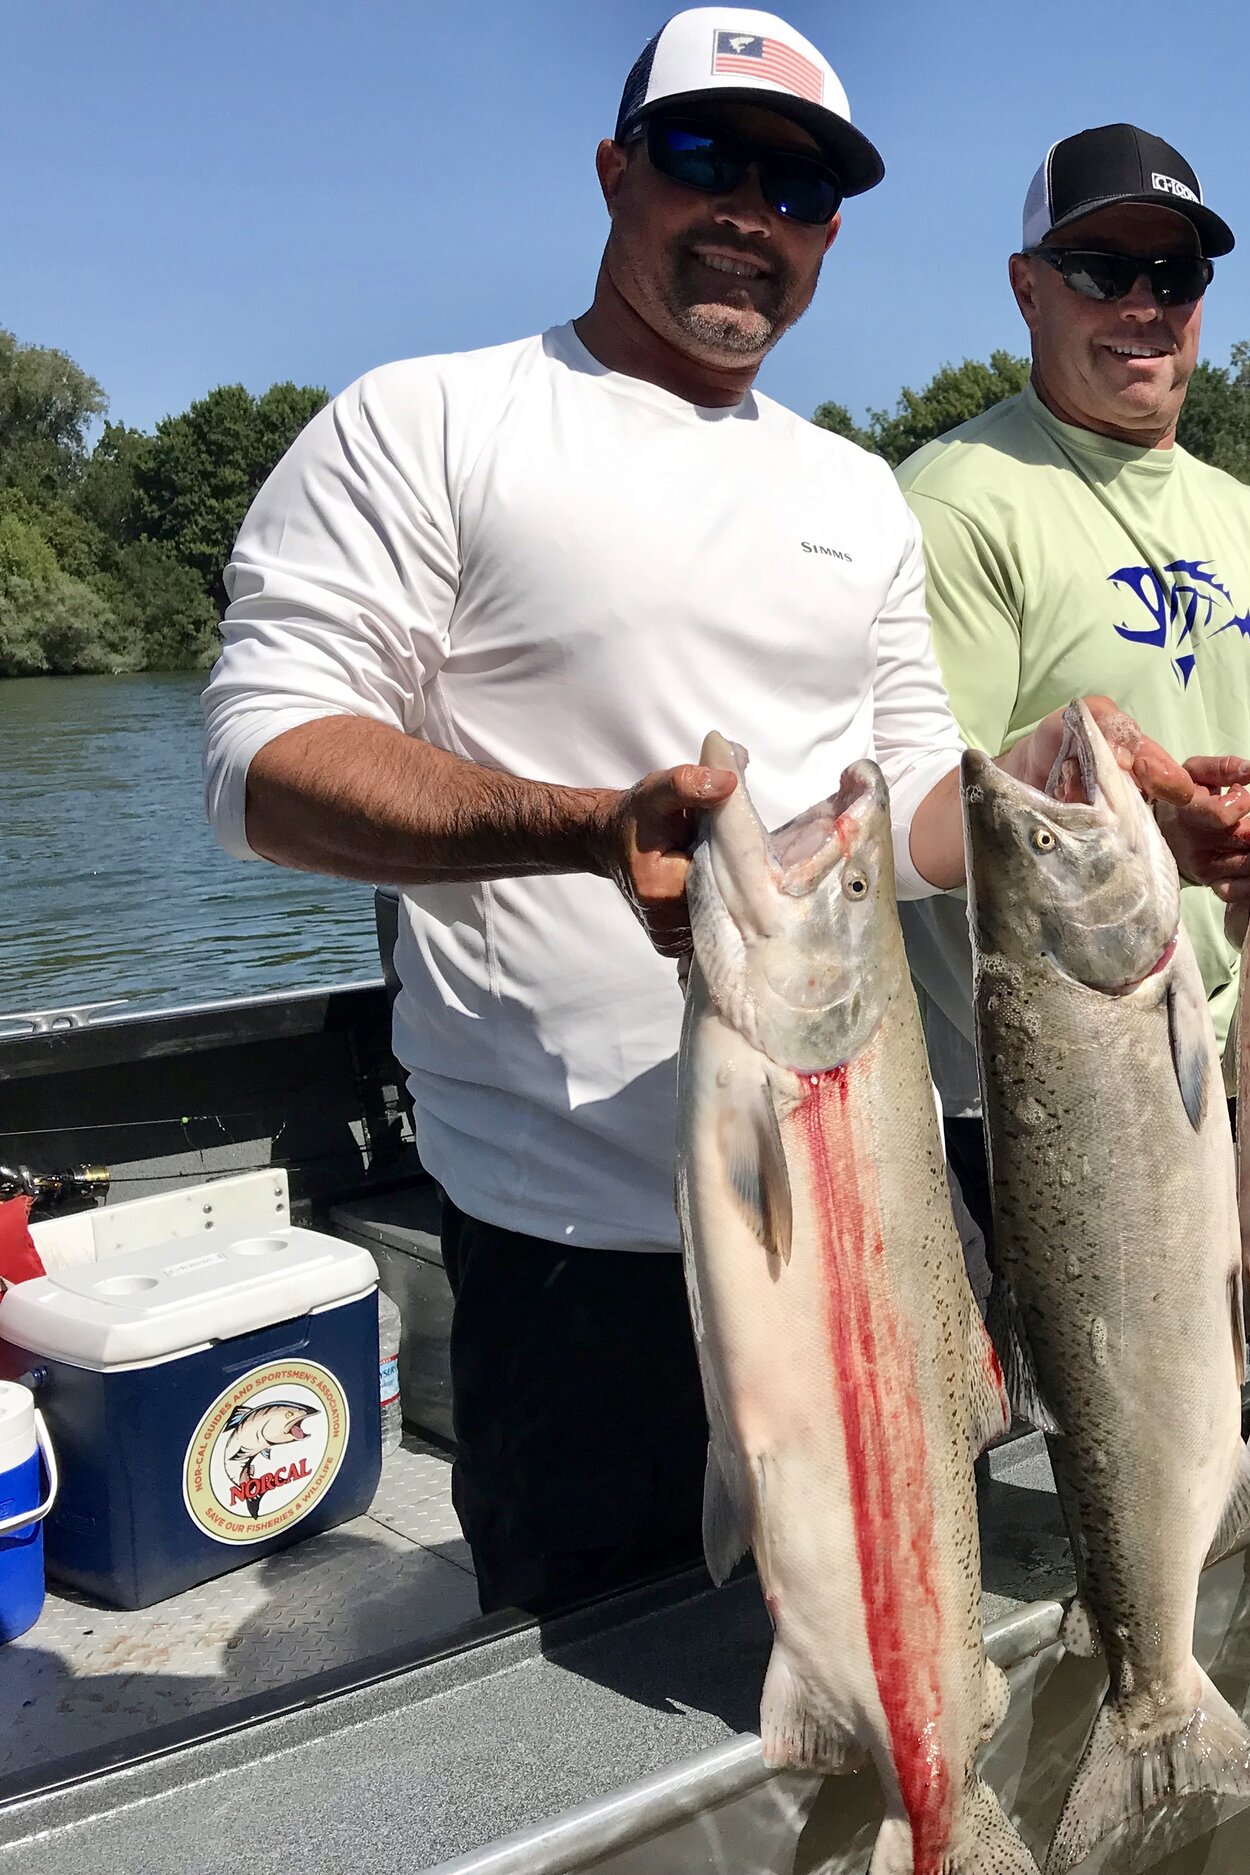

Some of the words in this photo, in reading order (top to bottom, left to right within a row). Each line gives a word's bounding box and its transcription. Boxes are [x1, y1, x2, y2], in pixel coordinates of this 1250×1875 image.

[801, 541, 853, 563] SIMMS
[194, 1442, 209, 1493] NOR-CAL
[204, 1402, 232, 1441] GUIDES
[232, 1383, 254, 1403] AND
[254, 1369, 318, 1388] SPORTSMEN'S
[315, 1379, 341, 1440] ASSOCIATION
[204, 1506, 226, 1528] SAVE
[225, 1520, 246, 1533] OUR
[246, 1509, 295, 1533] FISHERIES
[295, 1502, 302, 1512] &
[302, 1456, 334, 1504] WILDLIFE
